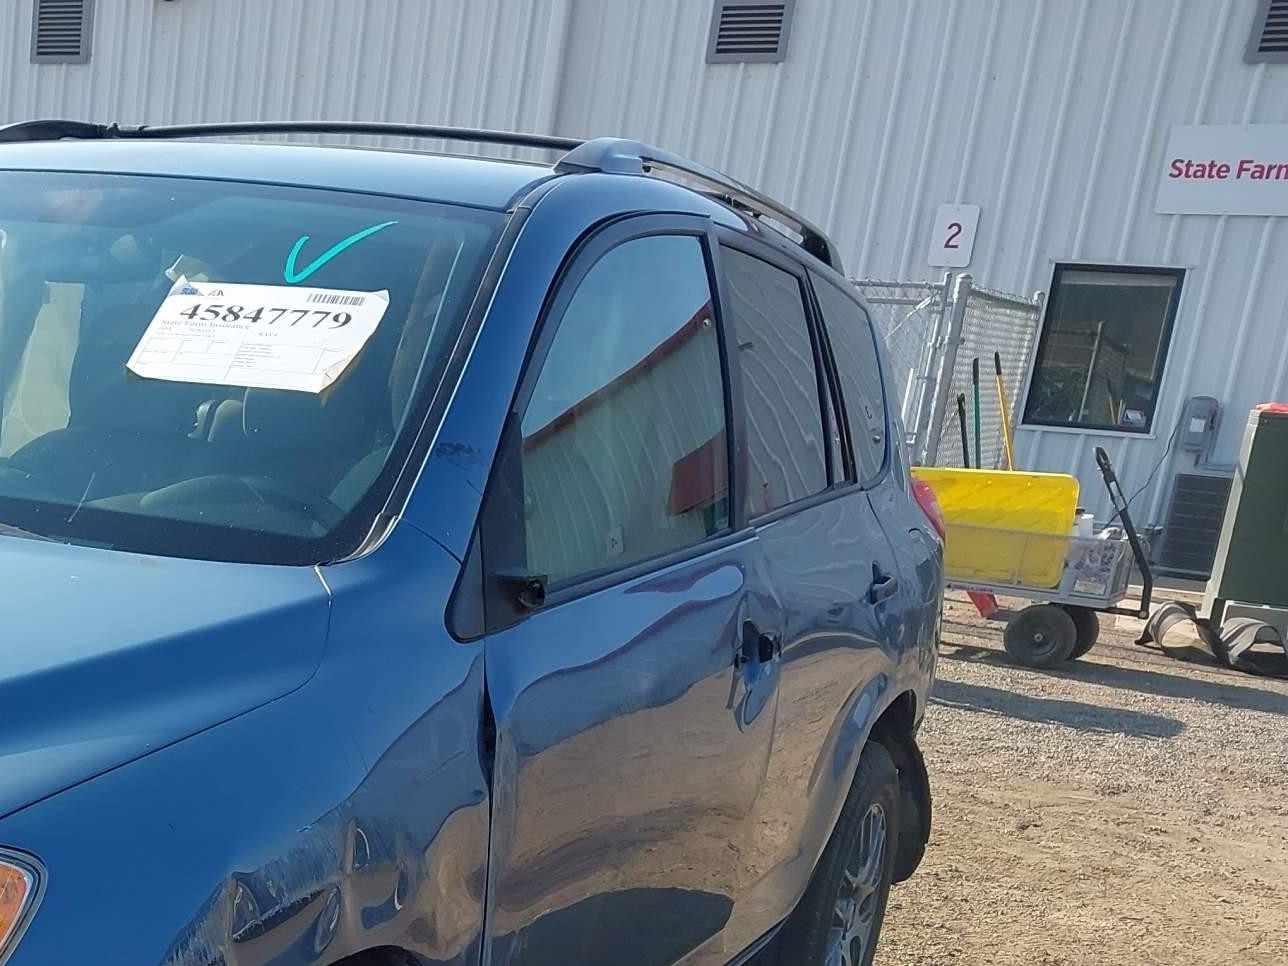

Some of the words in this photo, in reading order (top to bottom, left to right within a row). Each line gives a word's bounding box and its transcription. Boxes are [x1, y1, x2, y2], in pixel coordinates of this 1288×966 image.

[1168, 158, 1231, 179] State
[943, 222, 963, 249] 2
[179, 302, 352, 330] 45847779
